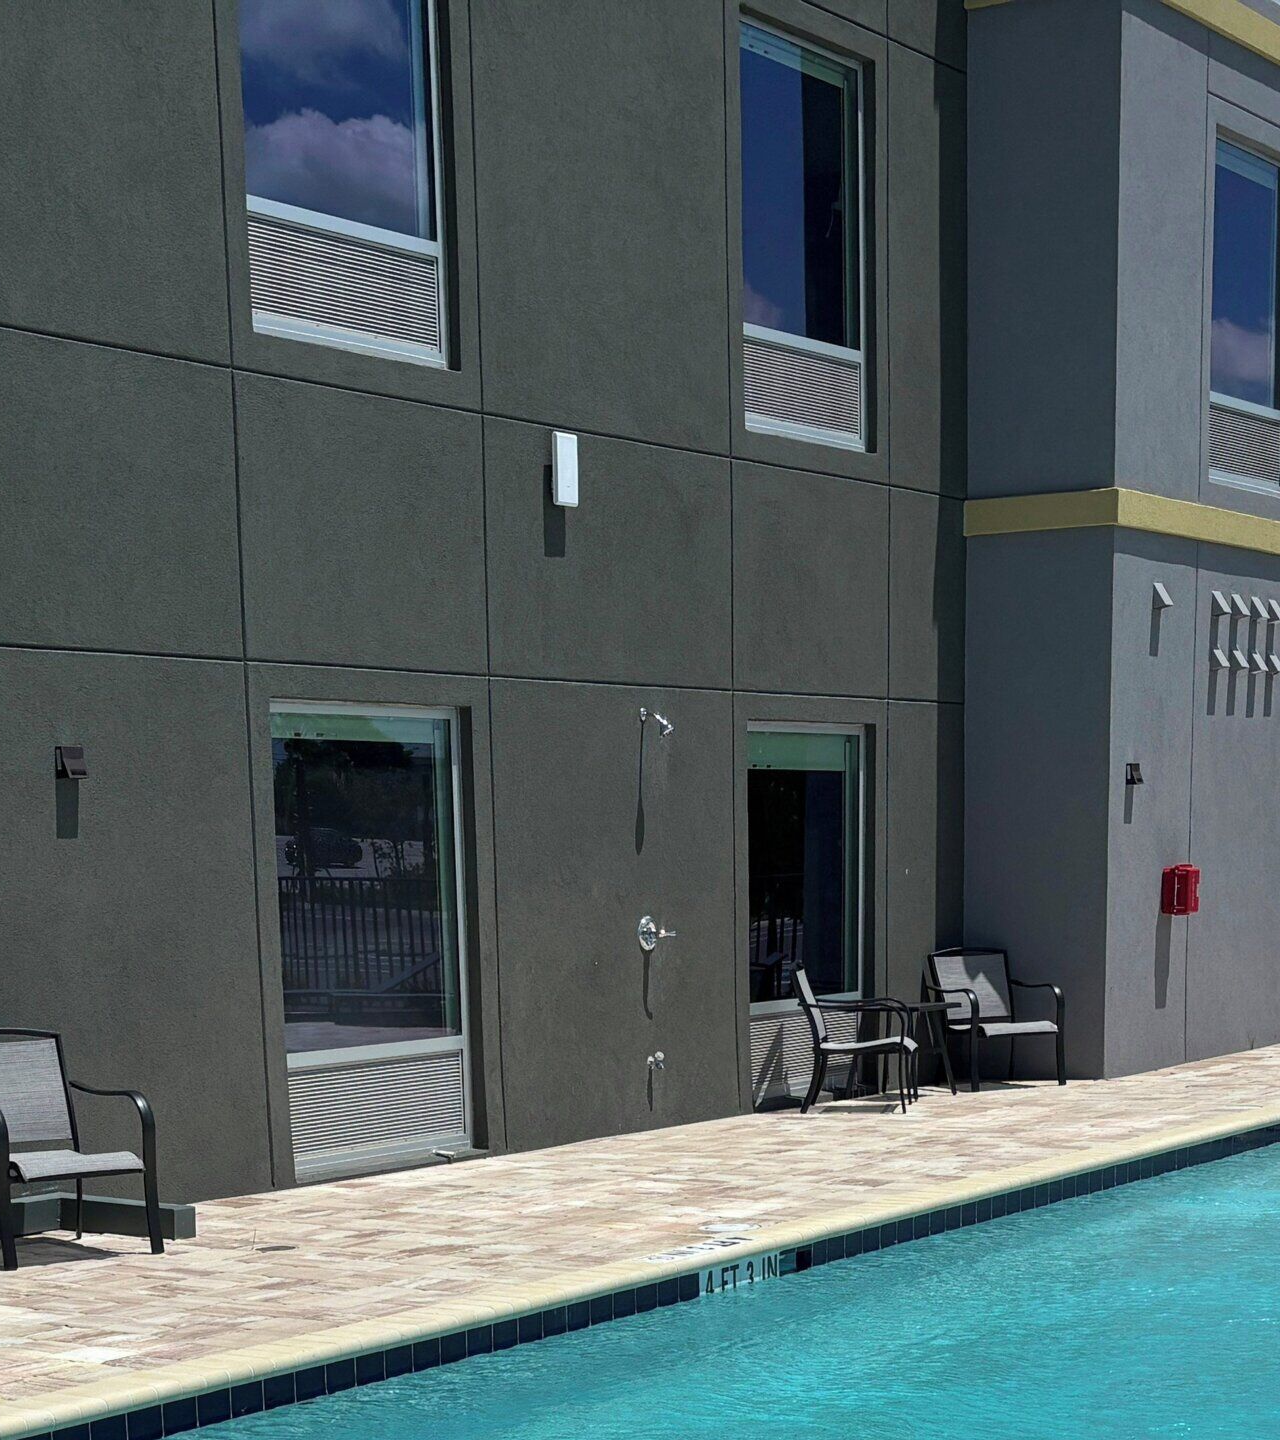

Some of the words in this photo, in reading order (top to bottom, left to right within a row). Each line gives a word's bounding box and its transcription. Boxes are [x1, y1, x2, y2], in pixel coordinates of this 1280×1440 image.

[705, 1270, 715, 1293] 4
[721, 1264, 740, 1291] FT
[746, 1261, 754, 1285] 3
[762, 1254, 778, 1280] IN
